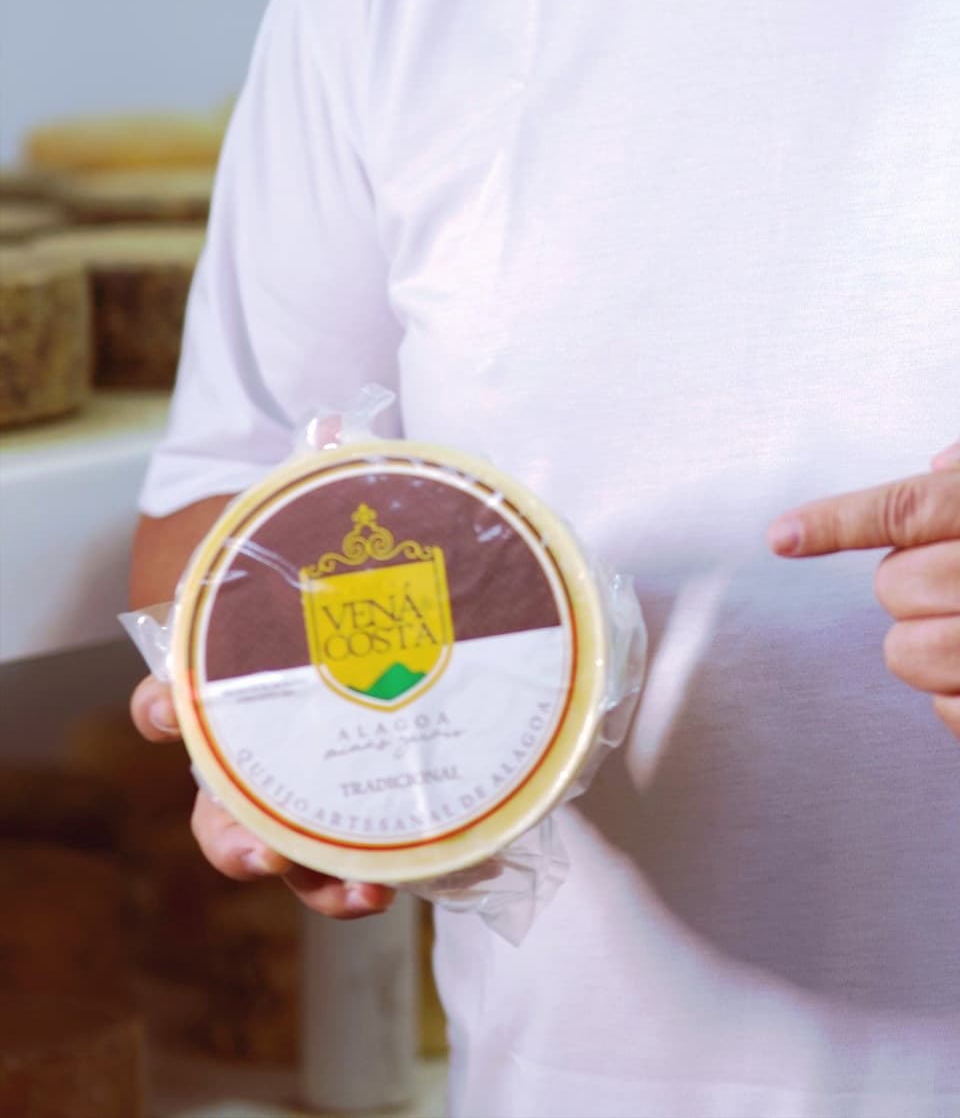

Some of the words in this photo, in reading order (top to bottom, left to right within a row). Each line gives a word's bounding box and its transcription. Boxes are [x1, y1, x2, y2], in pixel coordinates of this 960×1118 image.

[322, 622, 439, 661] COSTA
[338, 711, 451, 741] ALAGOA
[459, 785, 487, 808] DE
